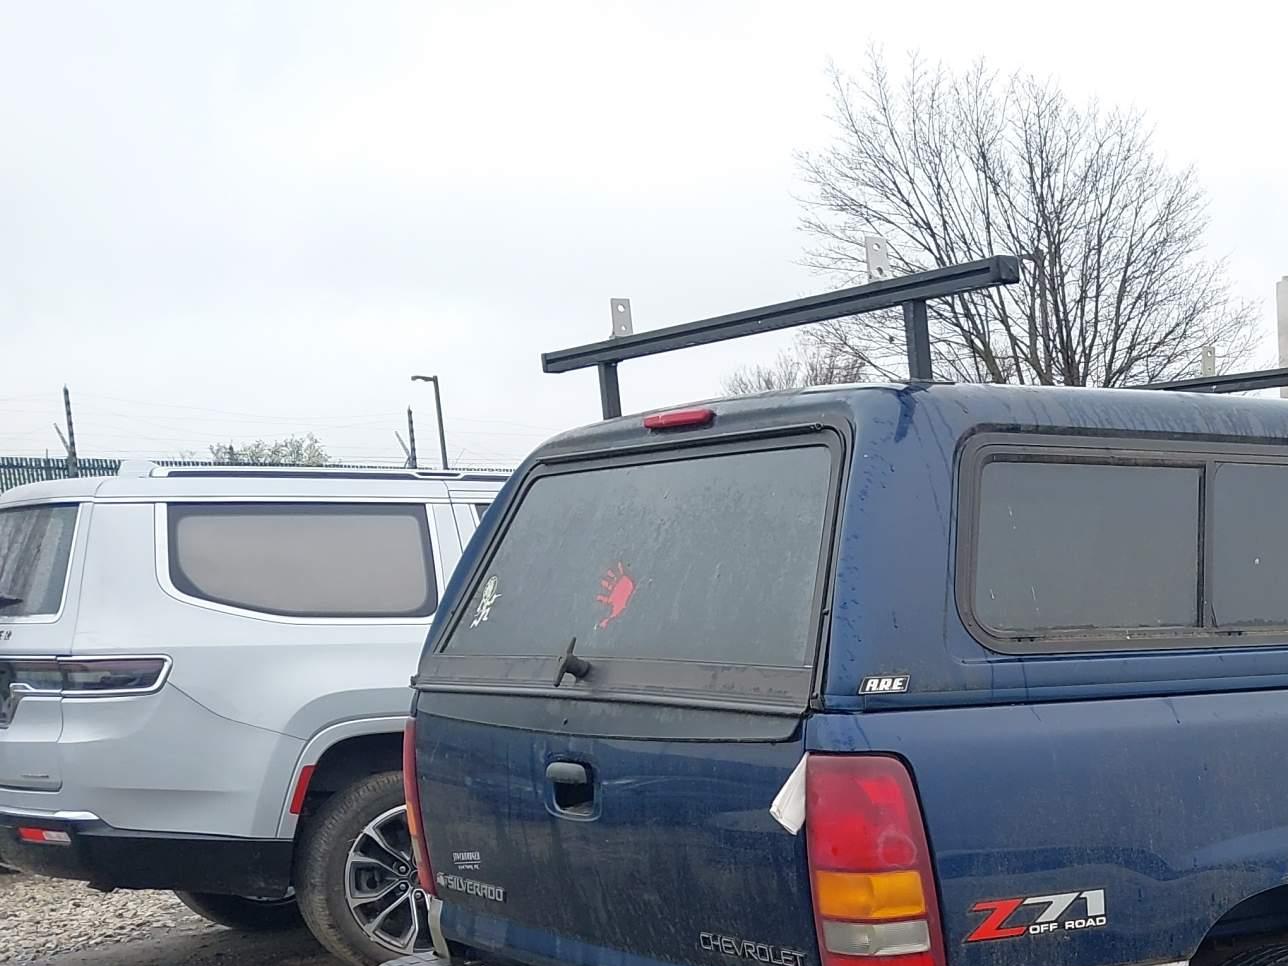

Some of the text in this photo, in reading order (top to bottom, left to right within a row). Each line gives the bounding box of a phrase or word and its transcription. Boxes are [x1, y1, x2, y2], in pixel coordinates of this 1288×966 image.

[447, 874, 505, 902] SILVERADO
[964, 888, 1106, 942] Z71
[1029, 916, 1107, 935] OFF ROAD
